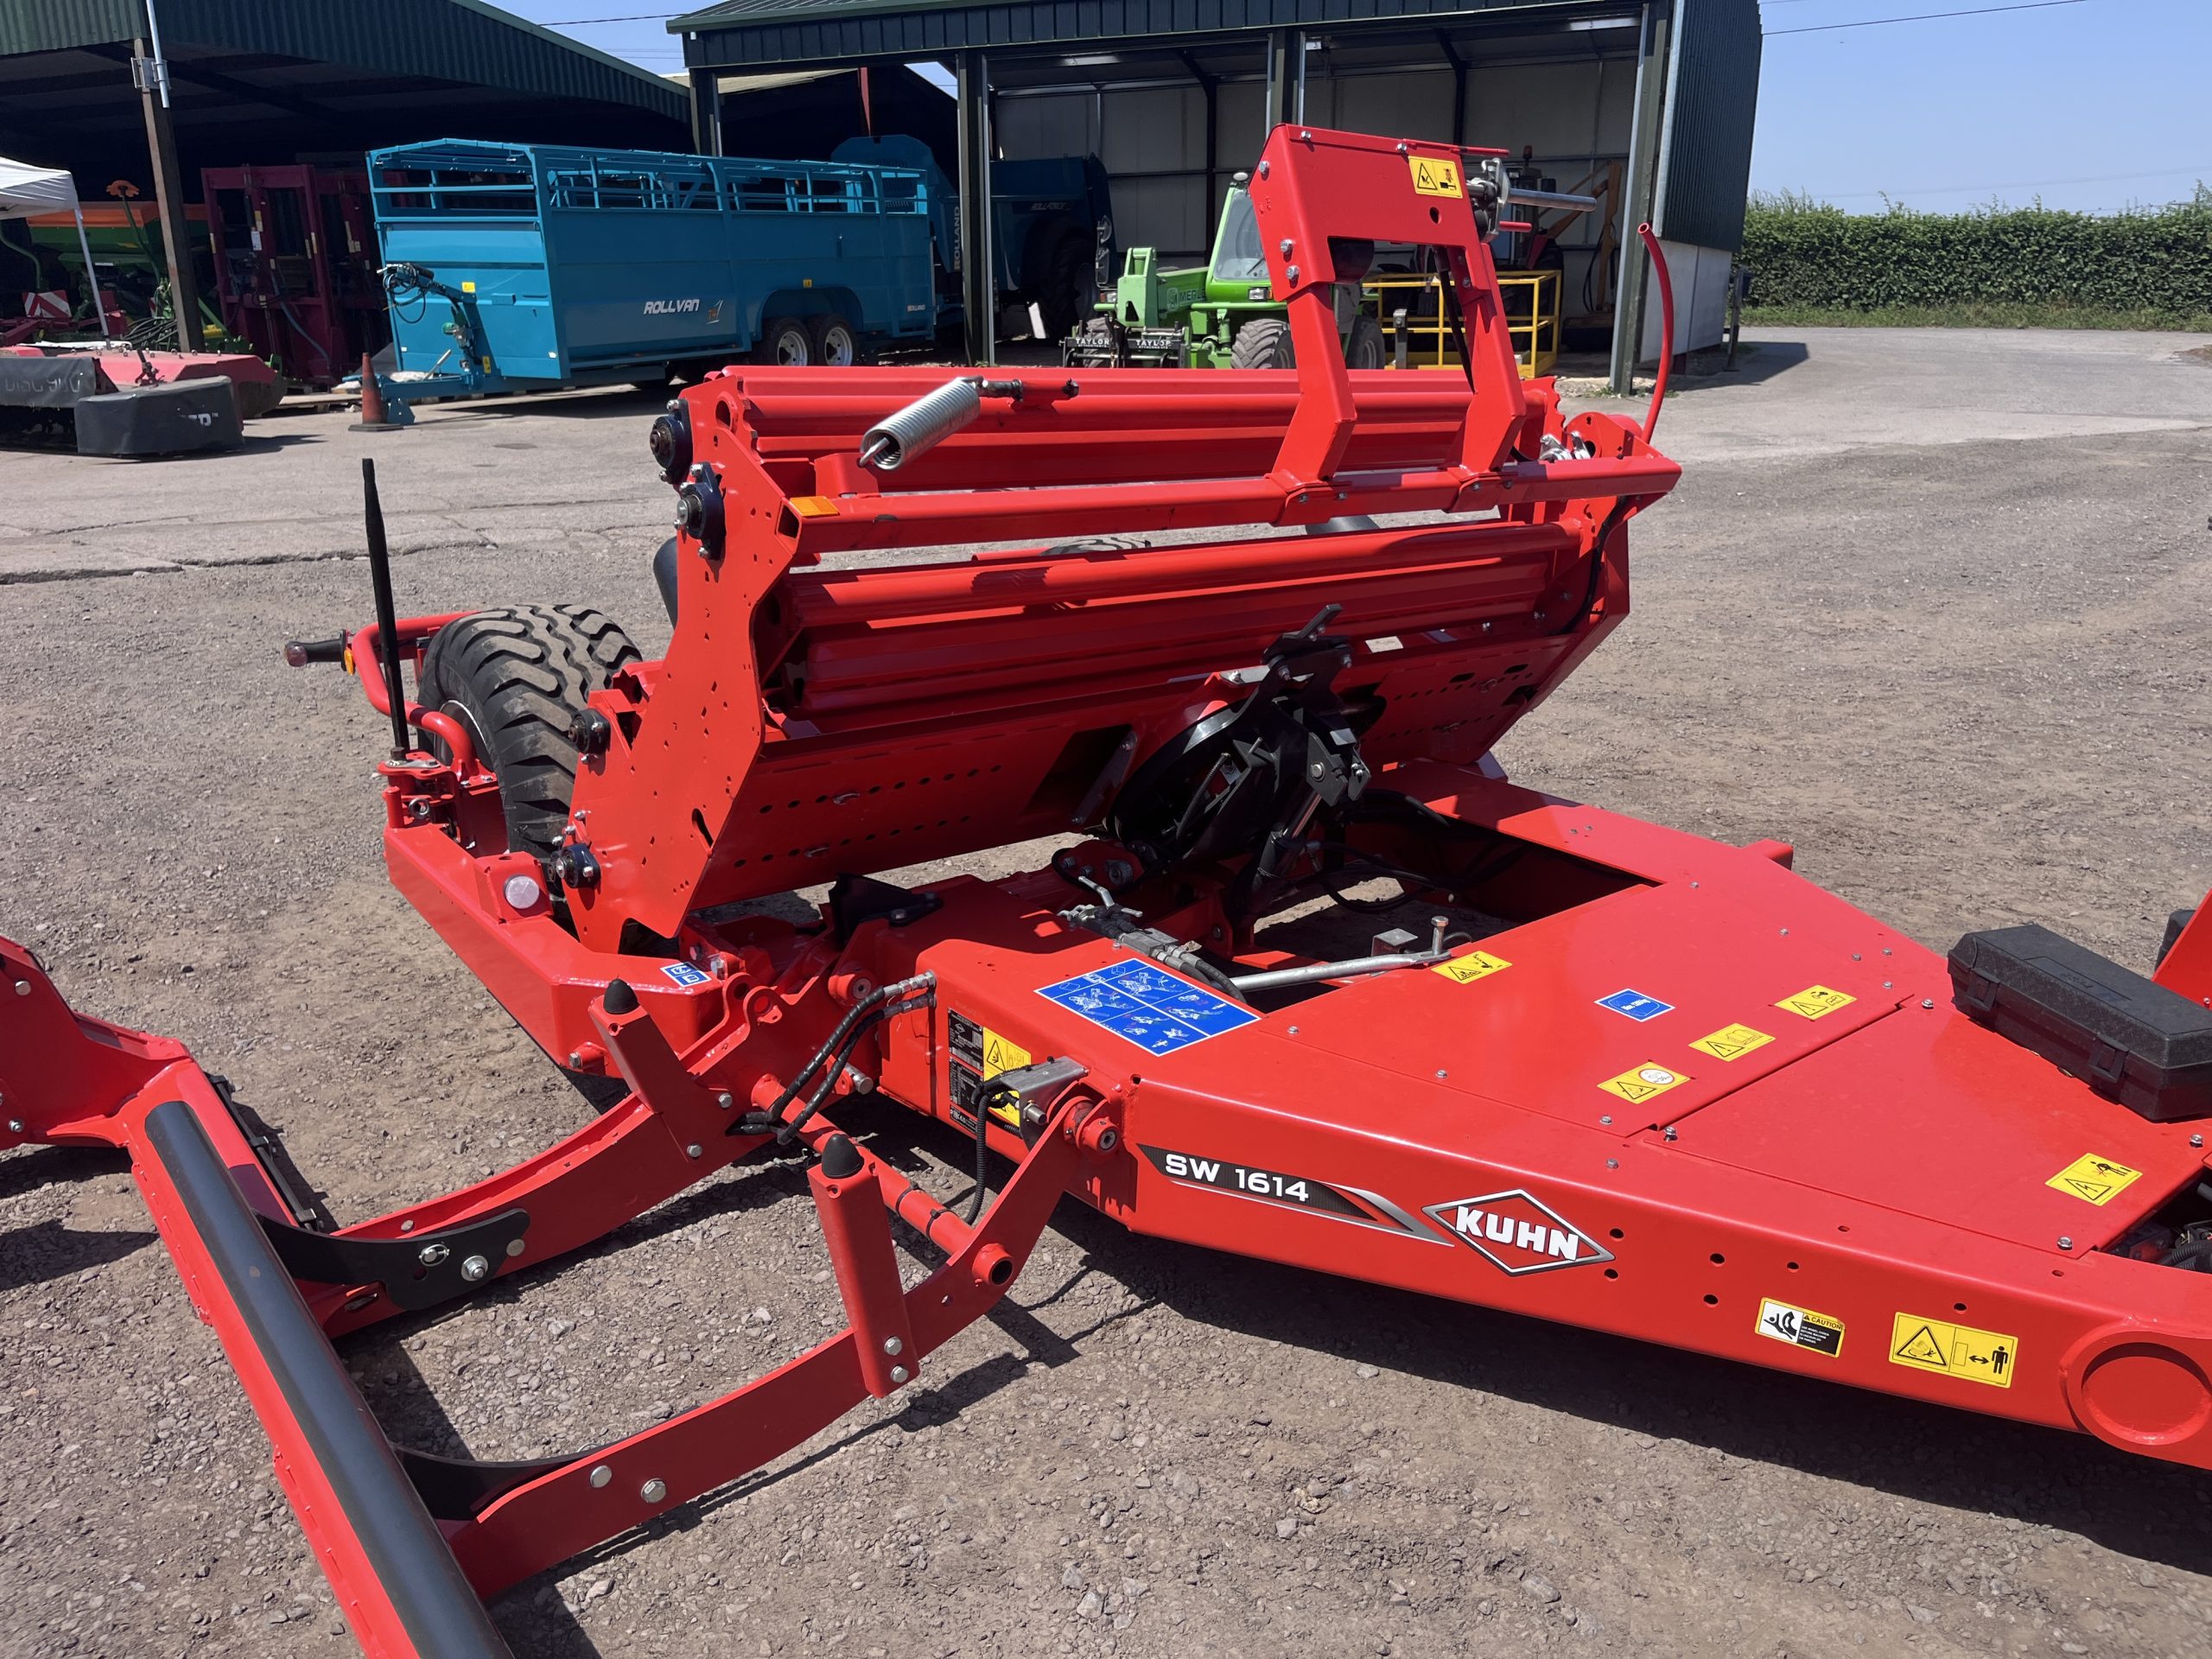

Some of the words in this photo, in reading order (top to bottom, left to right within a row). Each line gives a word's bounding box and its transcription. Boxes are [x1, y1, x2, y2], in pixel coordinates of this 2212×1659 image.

[643, 298, 700, 315] ROLLVAN
[1166, 1154, 1220, 1183] SW
[1236, 1168, 1309, 1202] 1614
[1455, 1205, 1580, 1261] KUHN
[1811, 1318, 1842, 1330] CAUTION
